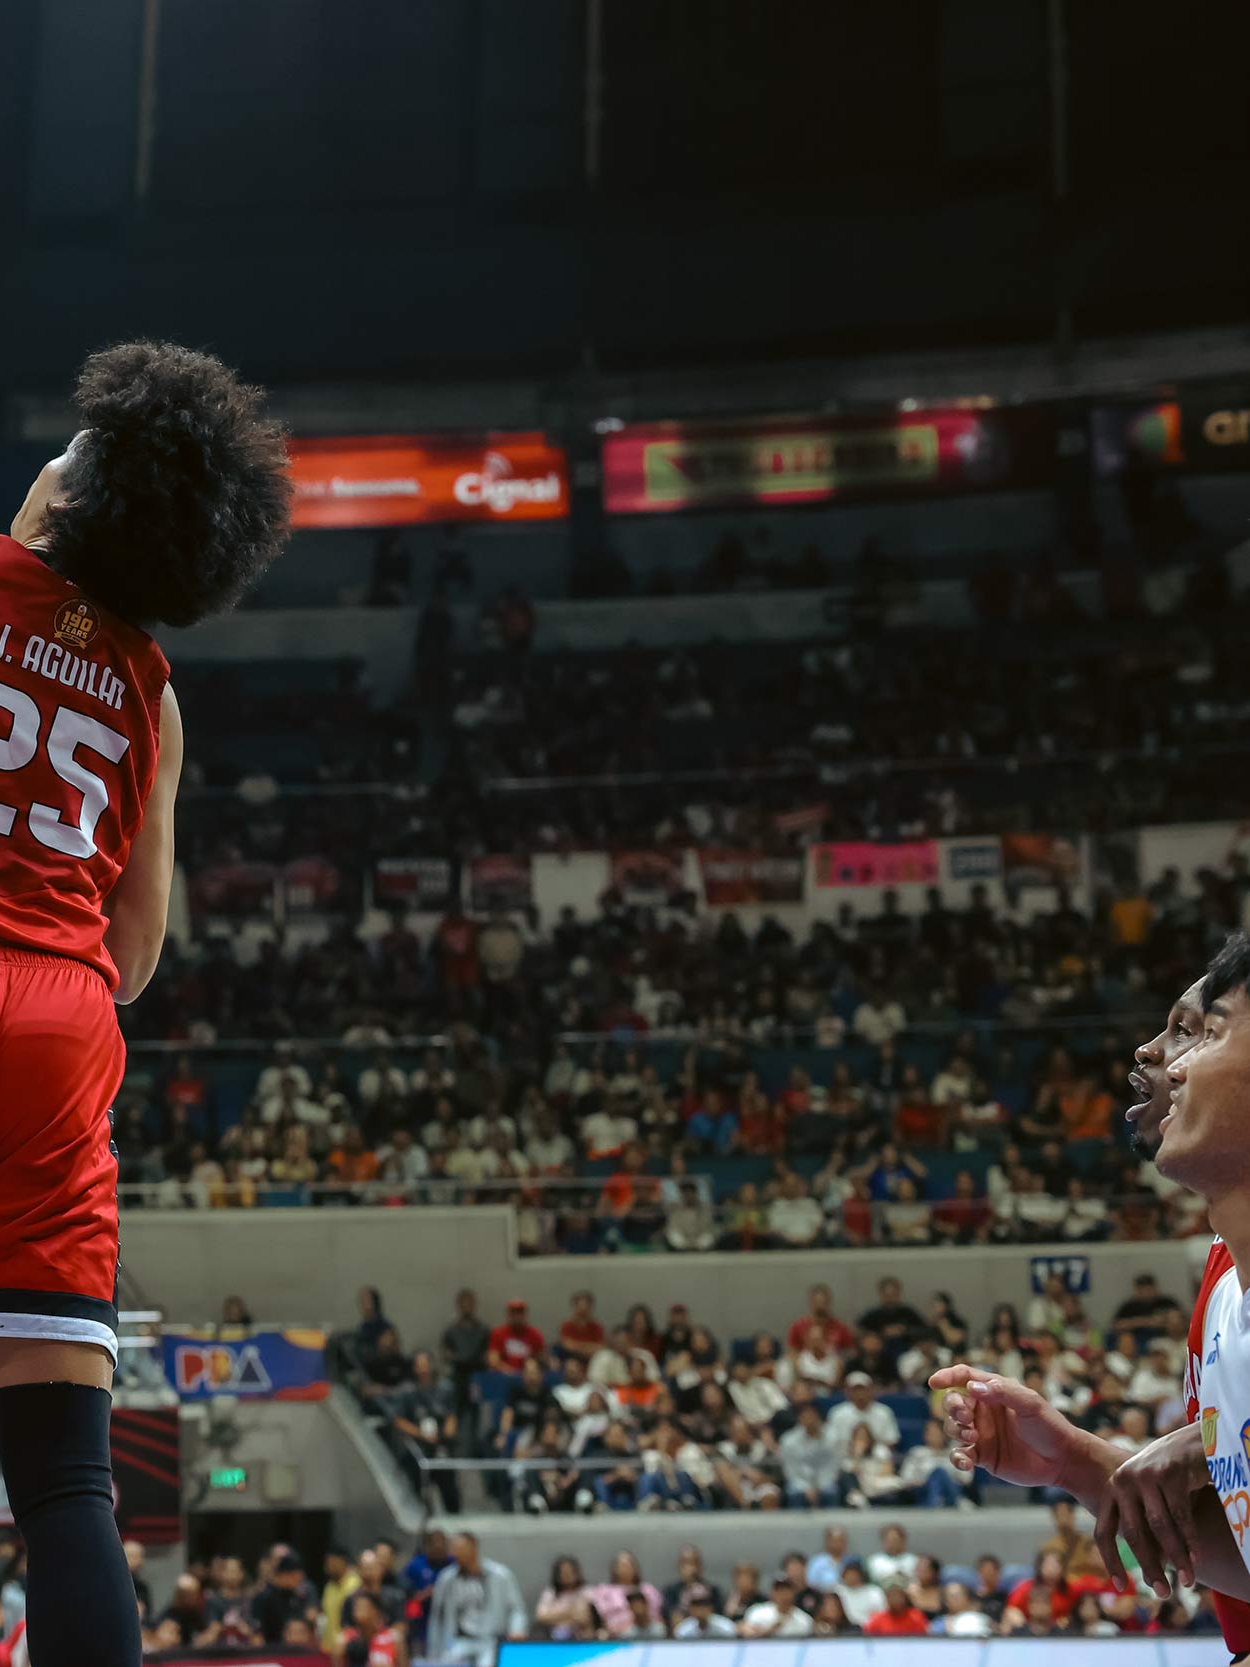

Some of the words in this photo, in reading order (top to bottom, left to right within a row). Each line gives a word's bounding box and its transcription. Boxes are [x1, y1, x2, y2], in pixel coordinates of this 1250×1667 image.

[453, 471, 562, 513] Cignal
[60, 622, 89, 640] YEARS
[62, 610, 94, 632] 190
[21, 634, 126, 711] AGUILAR
